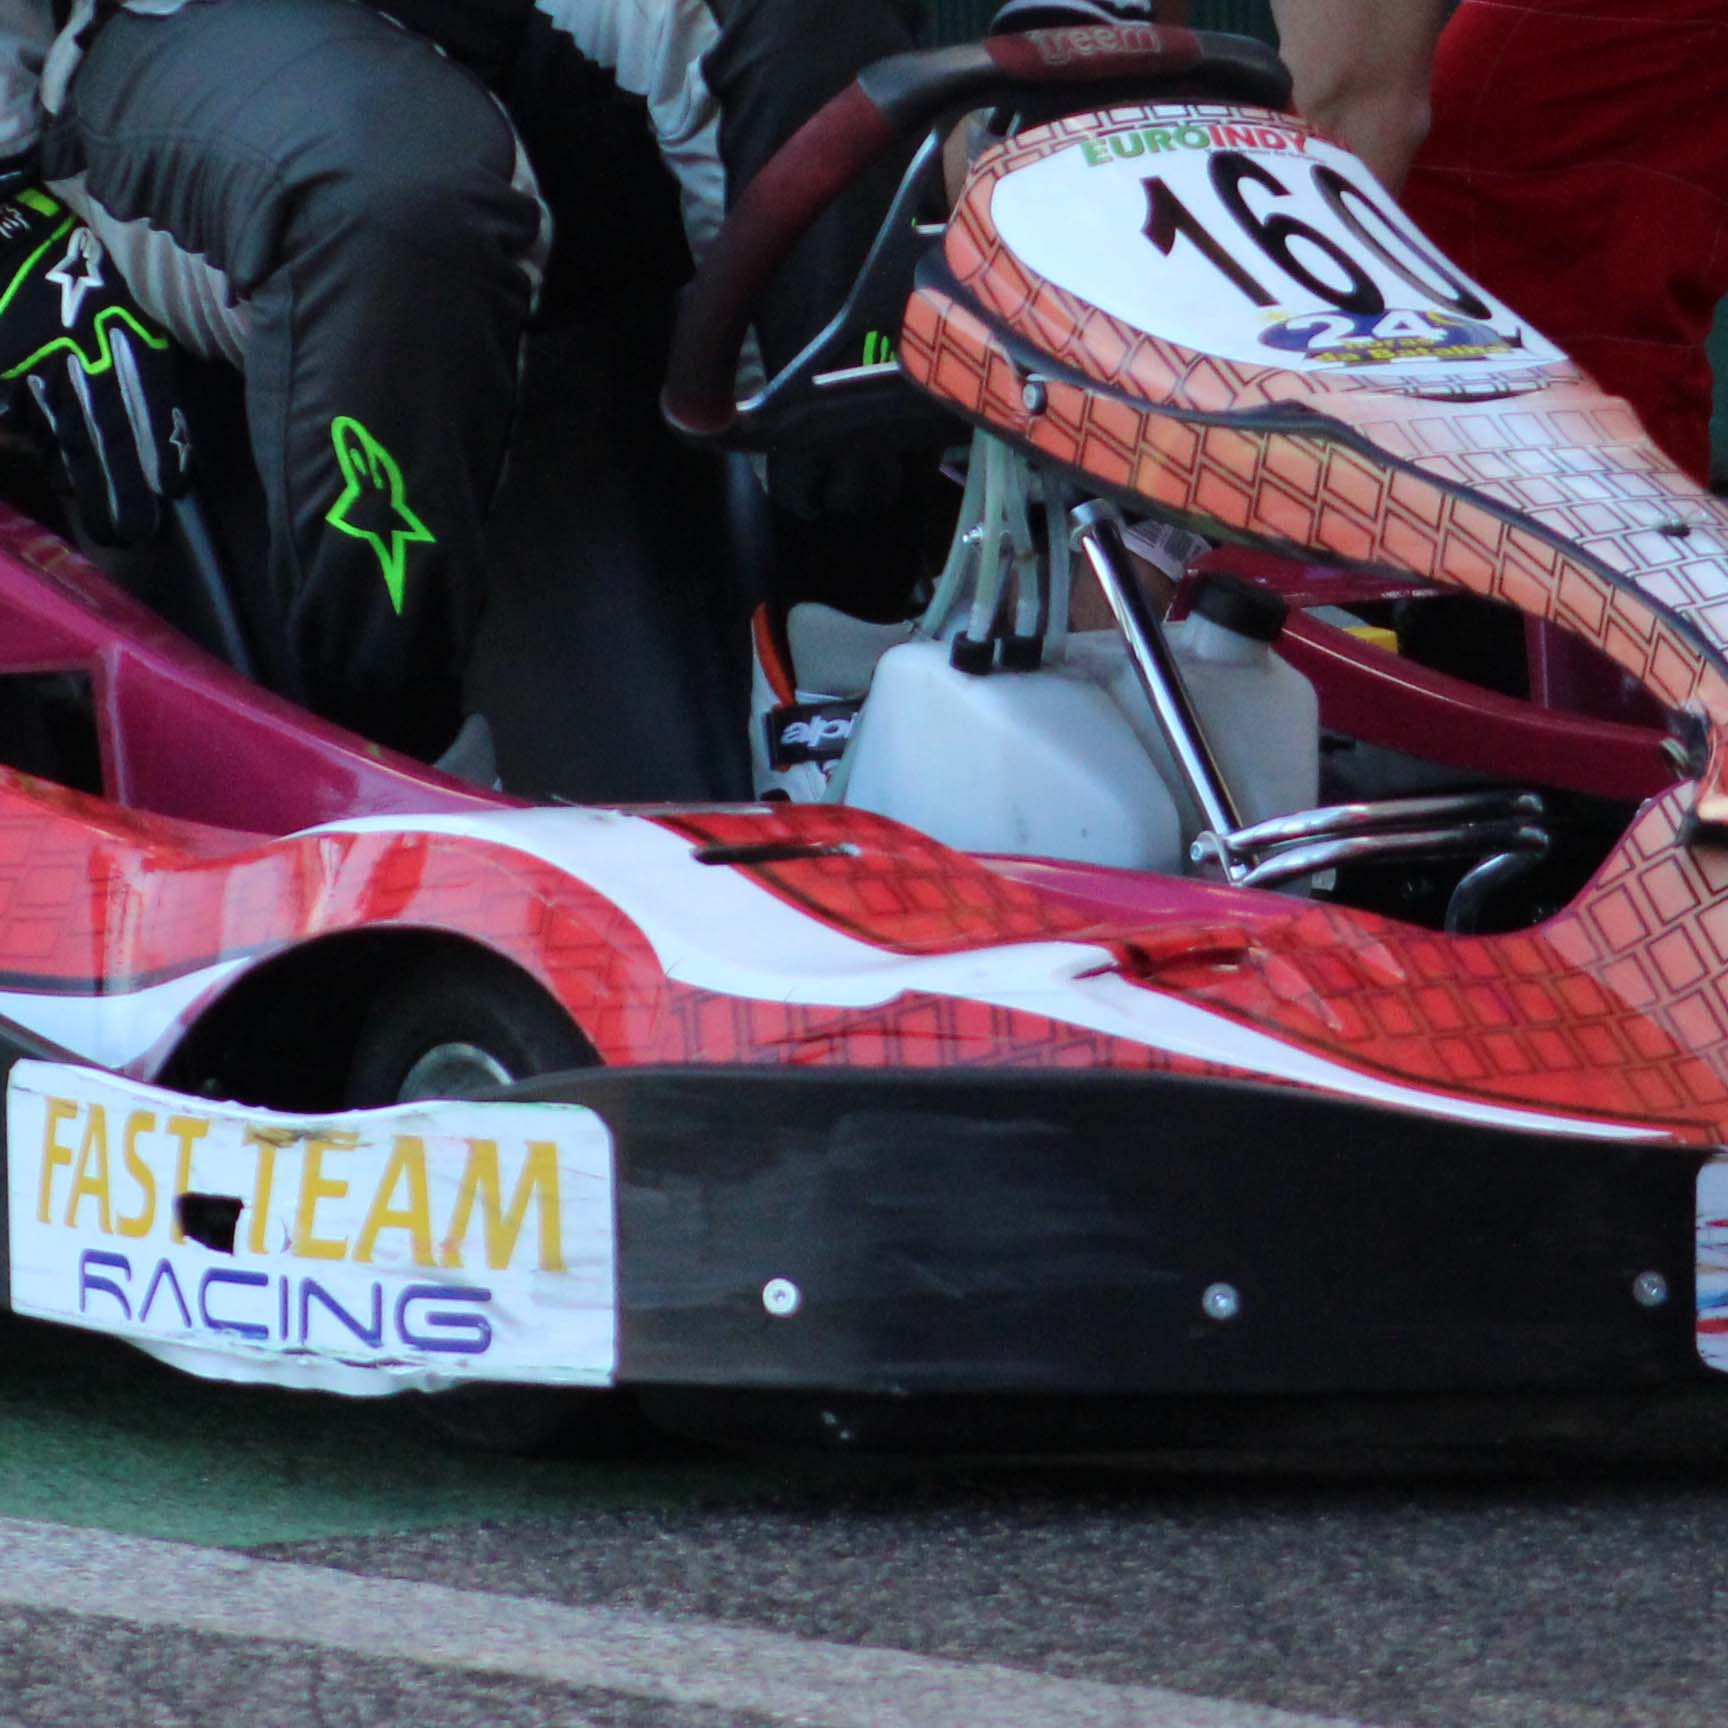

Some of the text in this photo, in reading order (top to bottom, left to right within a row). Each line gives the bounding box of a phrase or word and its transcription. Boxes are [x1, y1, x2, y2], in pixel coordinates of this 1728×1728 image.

[1139, 150, 1492, 320] 160
[1284, 309, 1449, 349] 24
[34, 1095, 567, 1273] FAST TEAM
[77, 1248, 493, 1355] RACING
